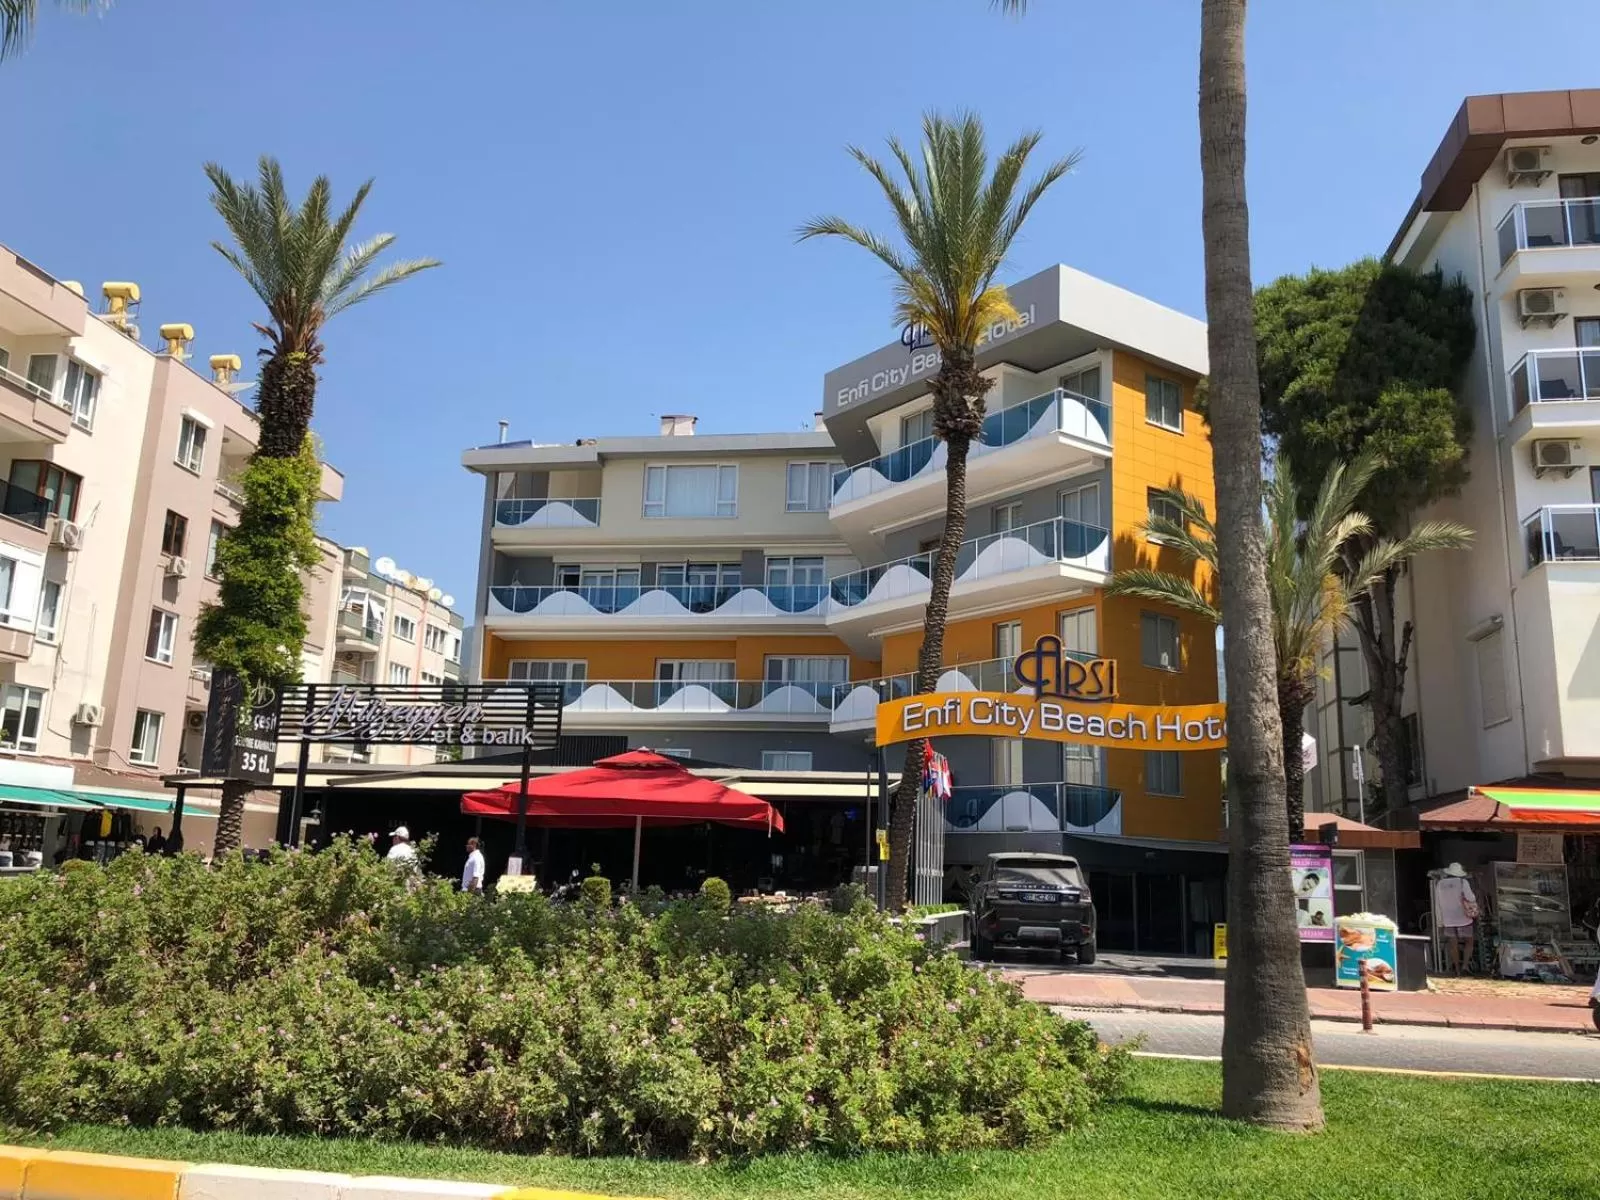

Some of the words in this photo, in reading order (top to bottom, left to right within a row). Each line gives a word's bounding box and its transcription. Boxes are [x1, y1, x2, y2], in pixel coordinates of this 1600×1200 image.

[837, 378, 869, 407] Enfi
[872, 364, 910, 391] City
[433, 728, 453, 744] et
[460, 725, 477, 744] &
[903, 698, 961, 732] Enfi
[969, 697, 1034, 734] City
[1040, 702, 1147, 740] Beach
[1156, 713, 1228, 741] Hot
[241, 752, 257, 772] 35
